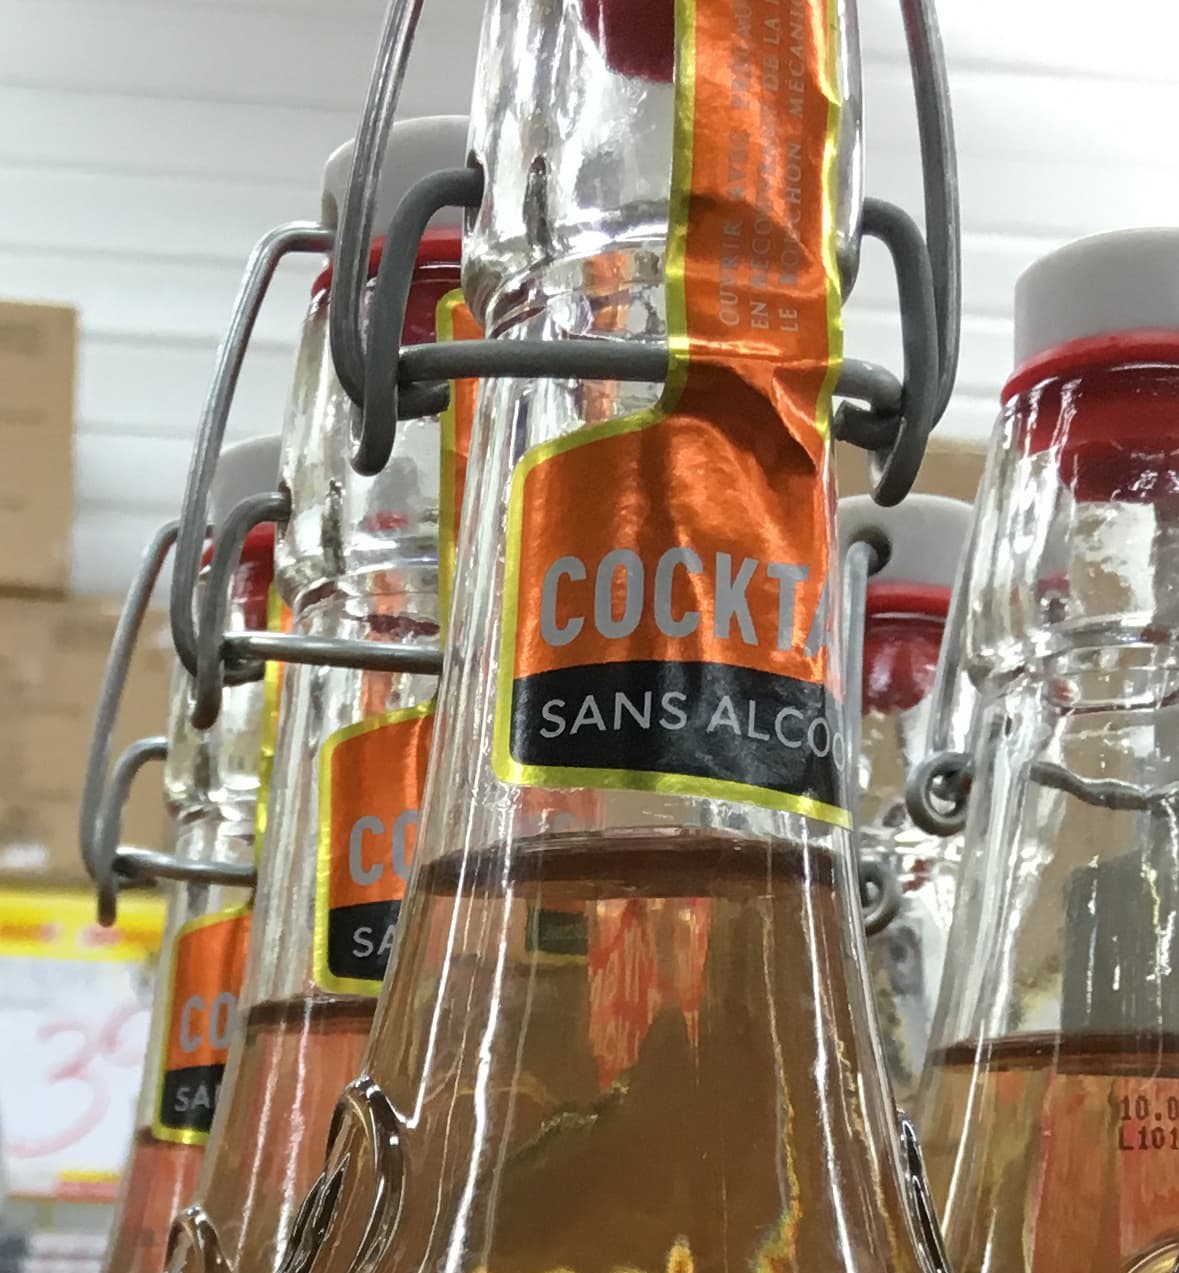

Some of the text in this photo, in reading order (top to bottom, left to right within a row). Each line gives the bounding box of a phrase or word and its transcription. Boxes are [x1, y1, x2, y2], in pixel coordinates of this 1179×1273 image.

[764, 17, 782, 45] LA
[763, 55, 781, 91] DE
[719, 218, 743, 326] OUVRIR
[750, 302, 769, 329] EN
[778, 308, 799, 332] LE
[539, 691, 847, 771] SANS ALCOO
[179, 991, 238, 1053] CO
